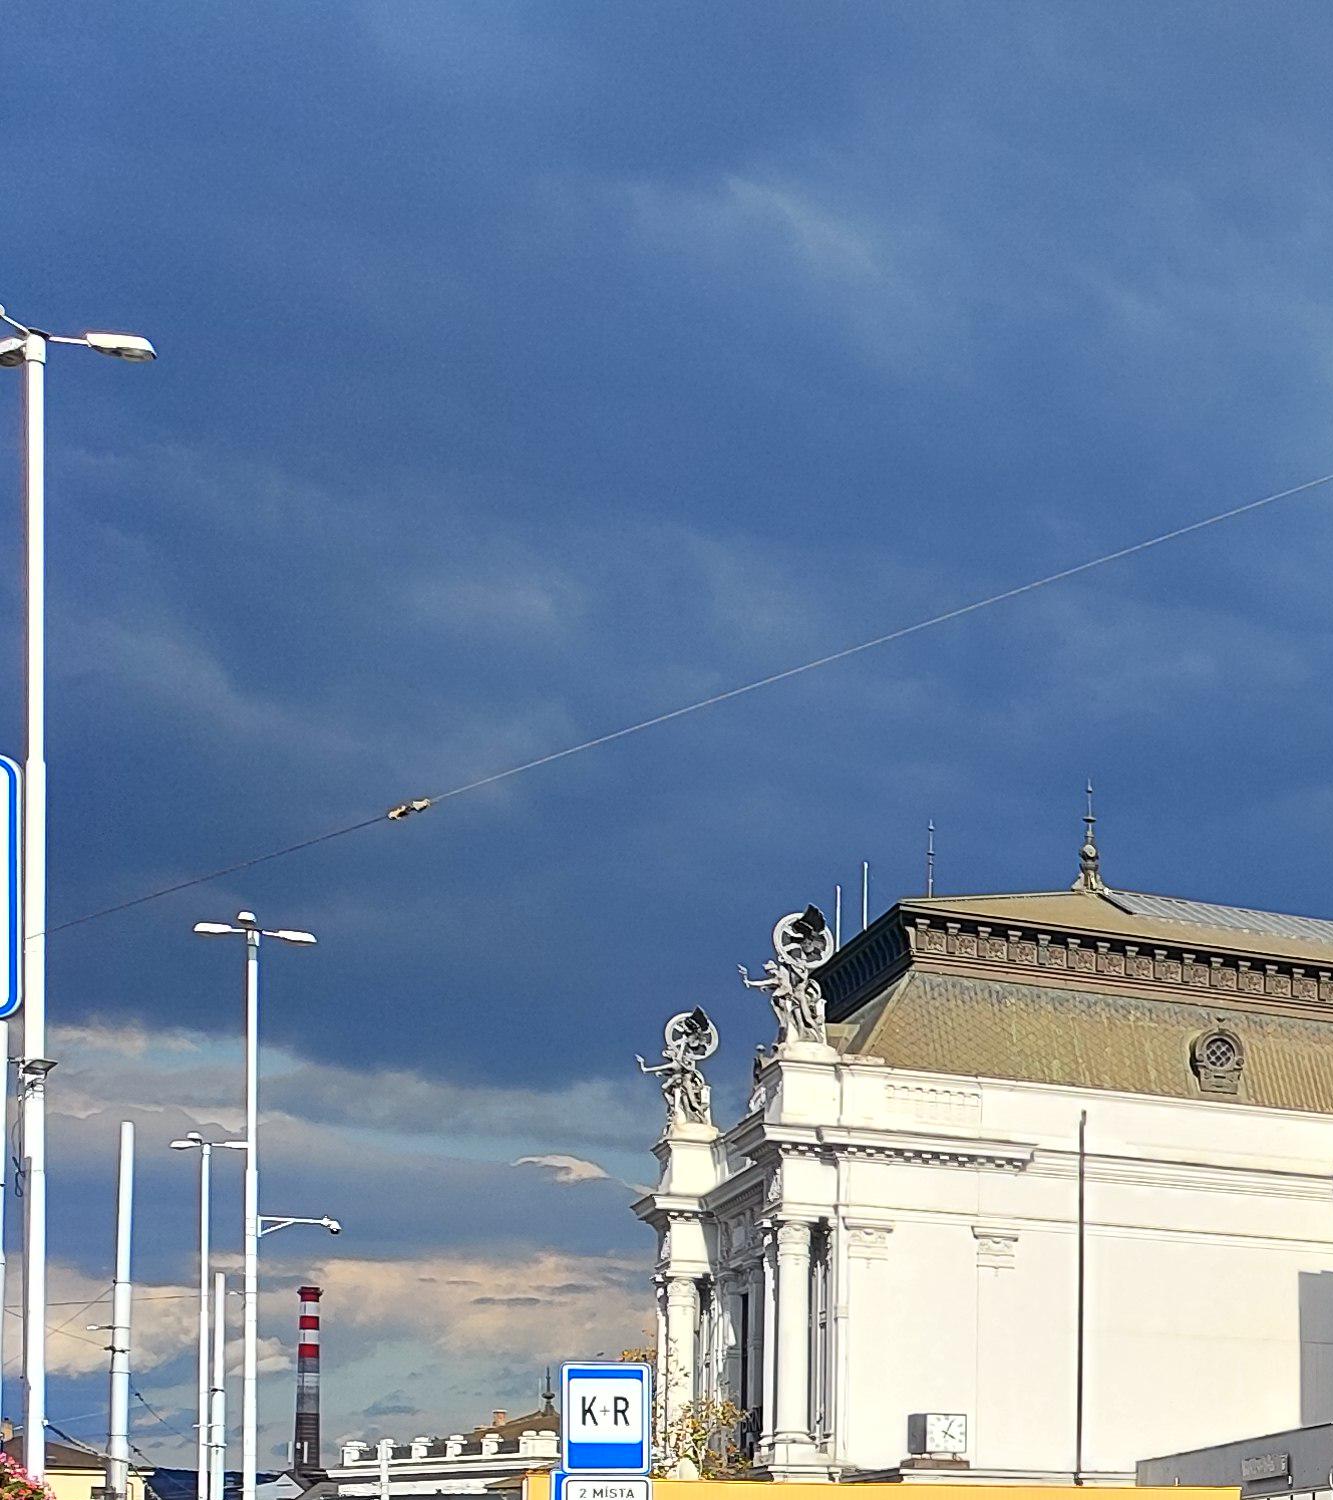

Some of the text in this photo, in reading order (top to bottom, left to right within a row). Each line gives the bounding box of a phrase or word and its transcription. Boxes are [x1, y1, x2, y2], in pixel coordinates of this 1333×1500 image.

[581, 1395, 630, 1427] K+R
[579, 1485, 635, 1499] 2 MÍSTA
